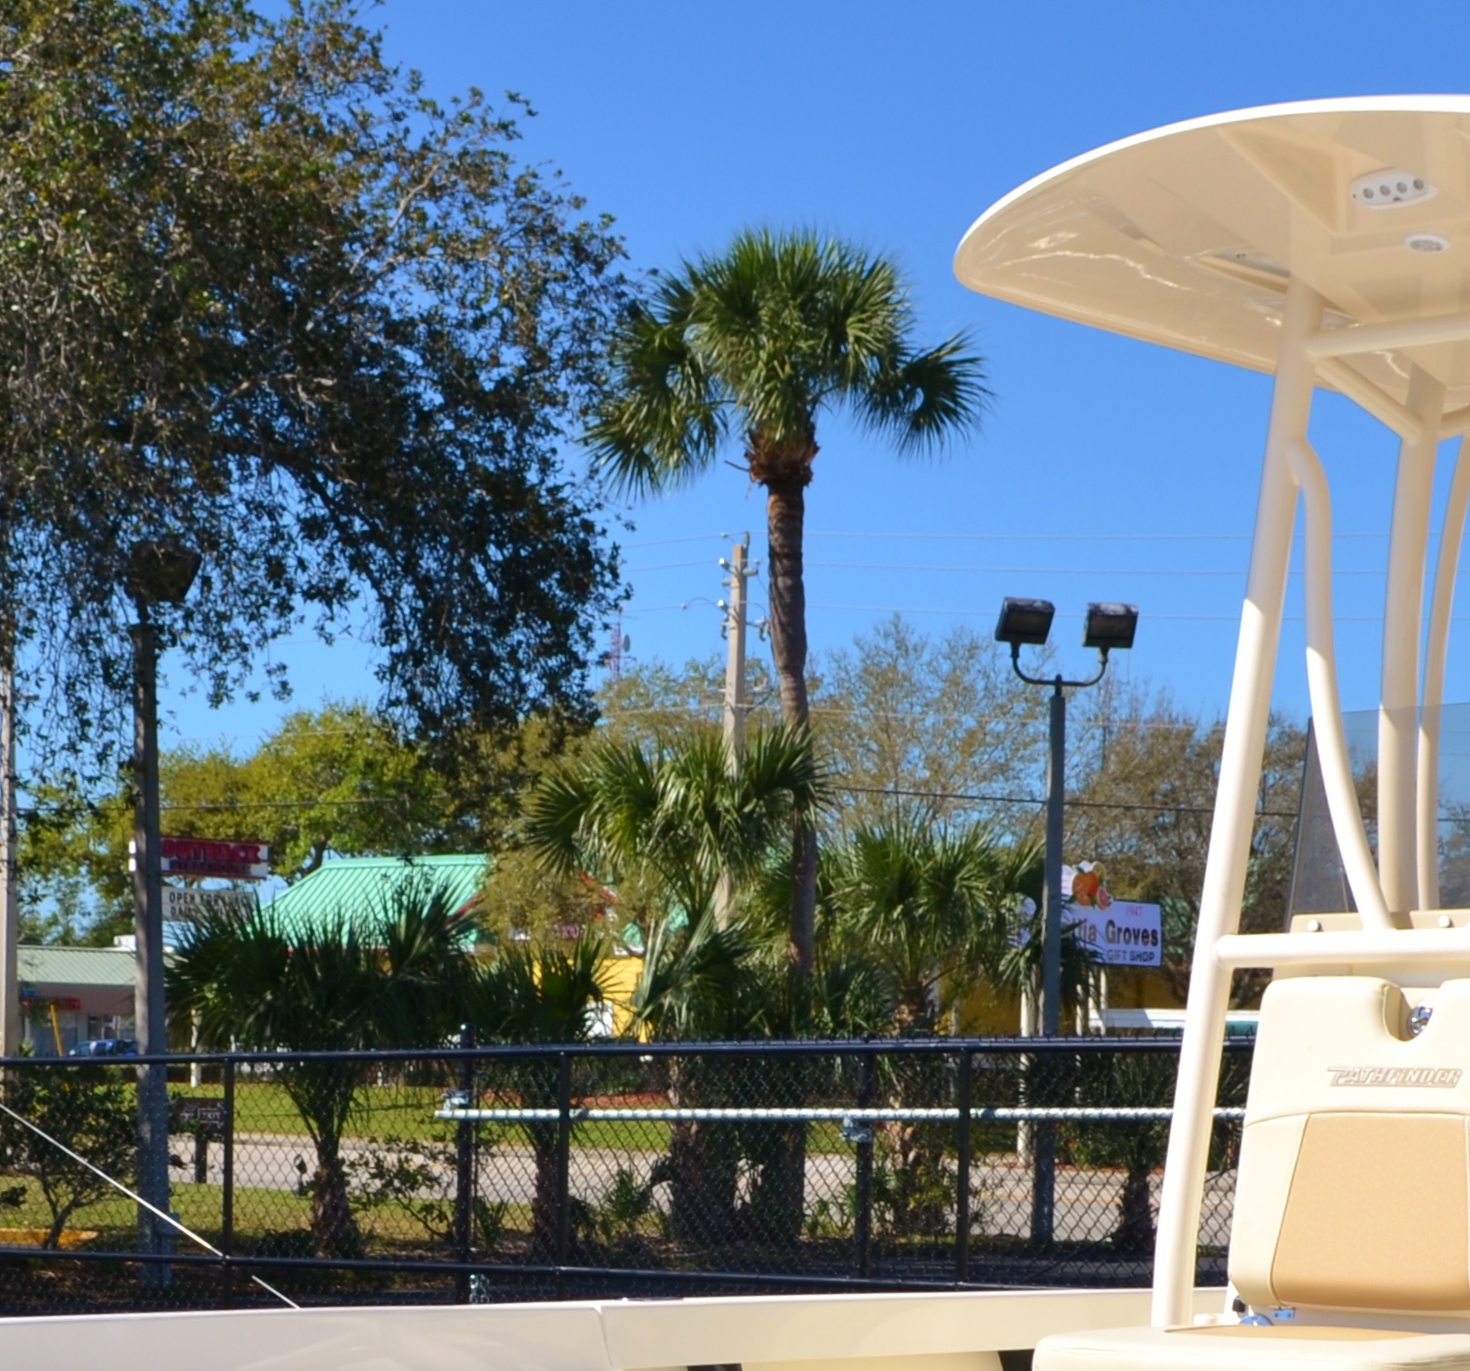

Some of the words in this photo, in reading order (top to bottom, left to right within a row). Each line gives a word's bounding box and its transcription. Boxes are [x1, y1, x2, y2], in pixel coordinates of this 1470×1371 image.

[169, 891, 196, 904] OPEN
[1105, 919, 1159, 947] Groves
[1106, 950, 1127, 961] GIFT
[1130, 951, 1155, 962] SHOP
[1326, 1066, 1463, 1088] PATHFINDER
